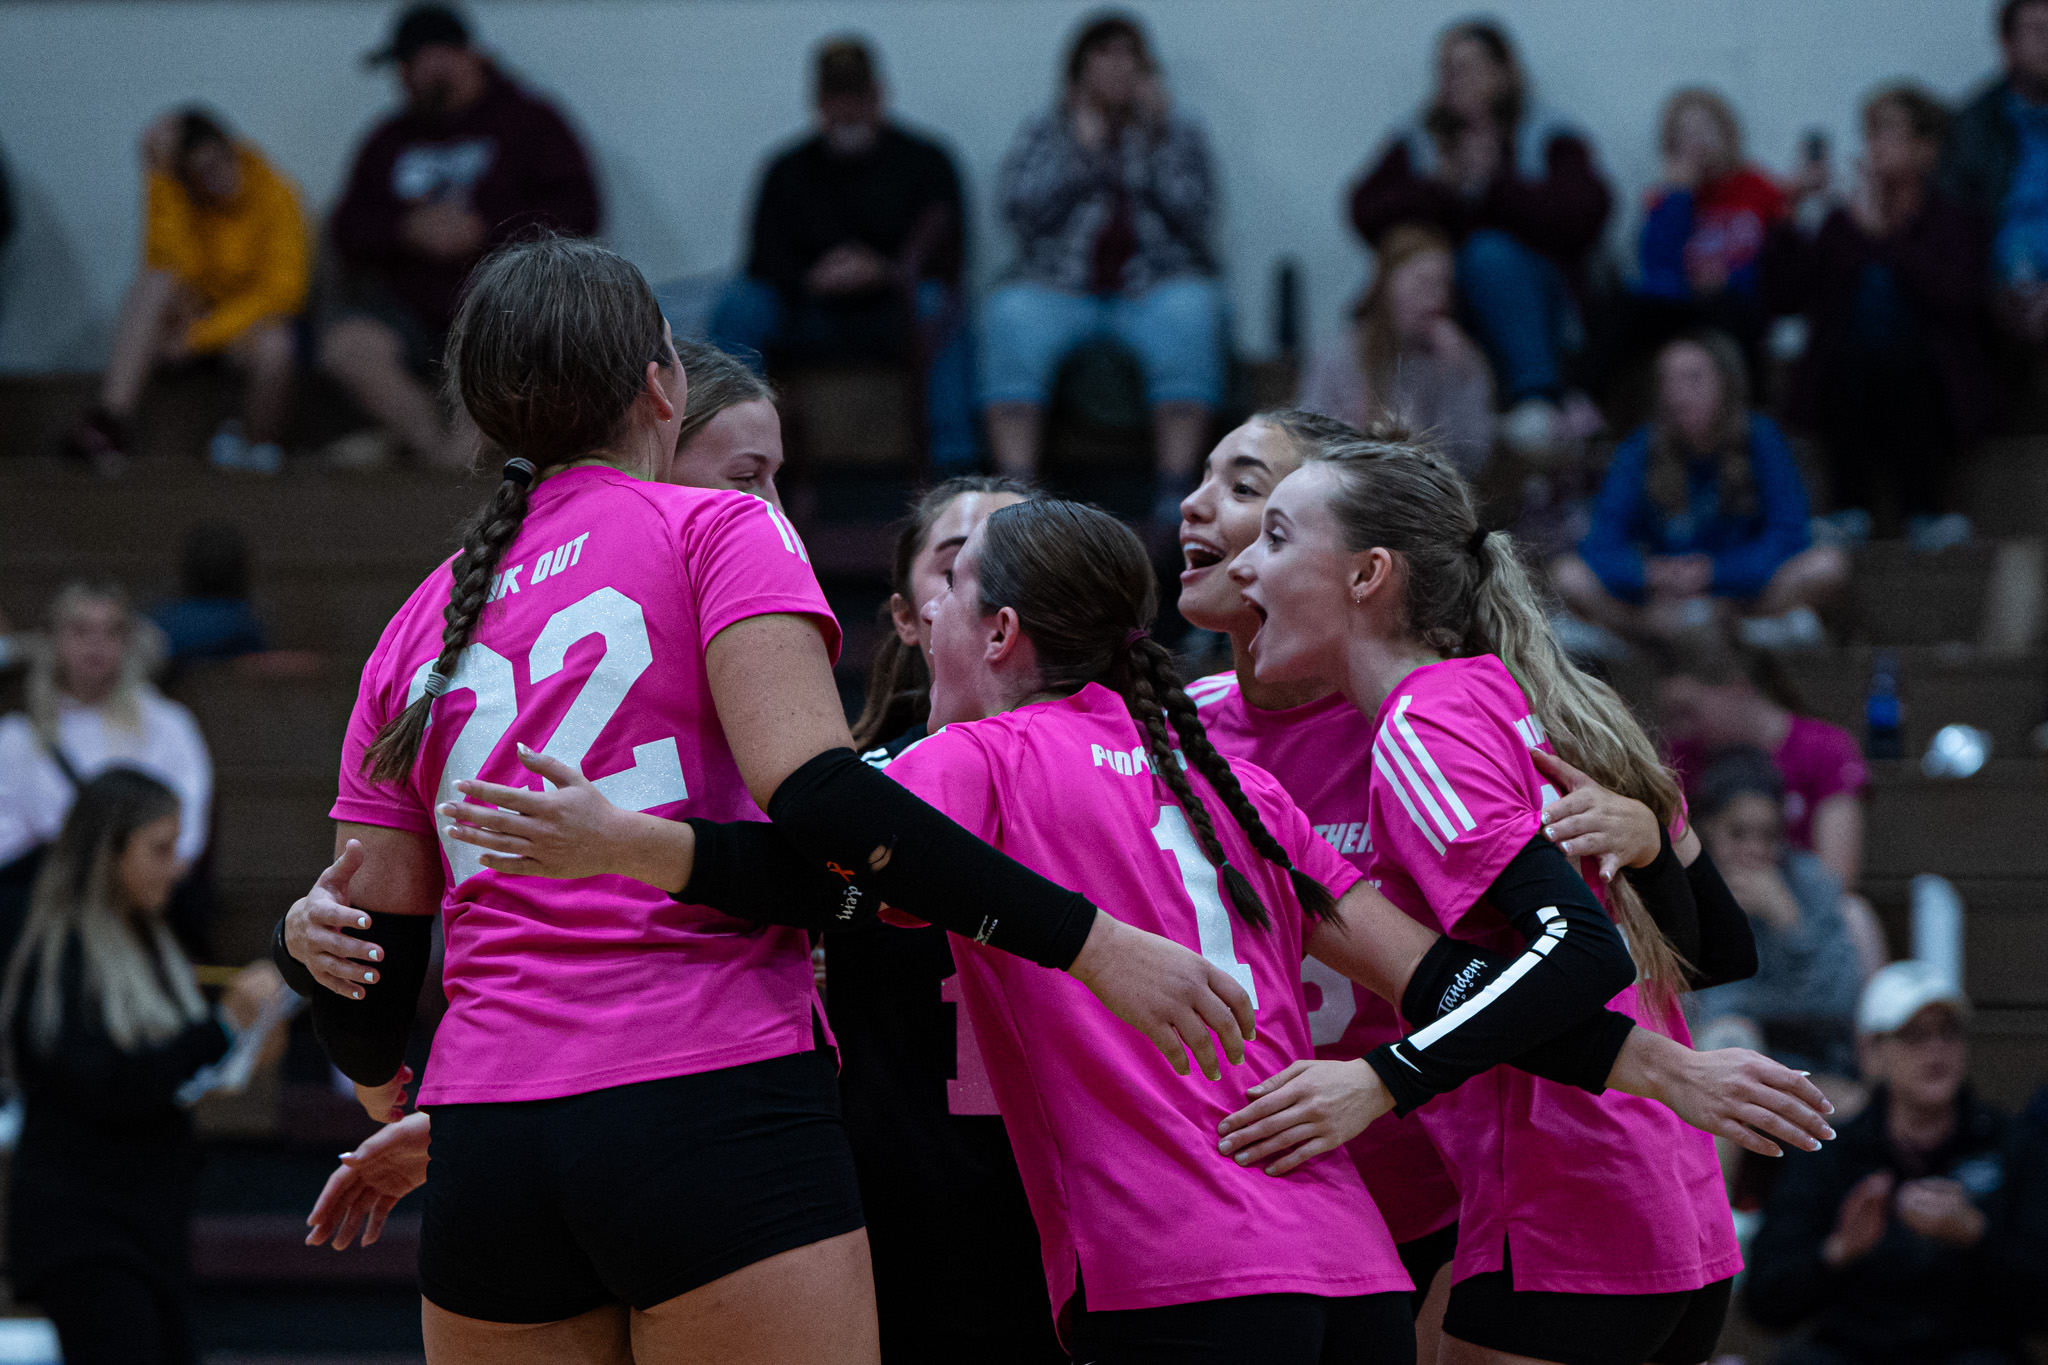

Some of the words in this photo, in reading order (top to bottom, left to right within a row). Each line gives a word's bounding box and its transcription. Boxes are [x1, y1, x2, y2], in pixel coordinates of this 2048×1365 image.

[530, 531, 590, 586] OUT
[406, 586, 689, 888] 22
[1090, 743, 1151, 777] PINK
[1150, 805, 1260, 1011] 1
[1436, 957, 1486, 1017] Tandem
